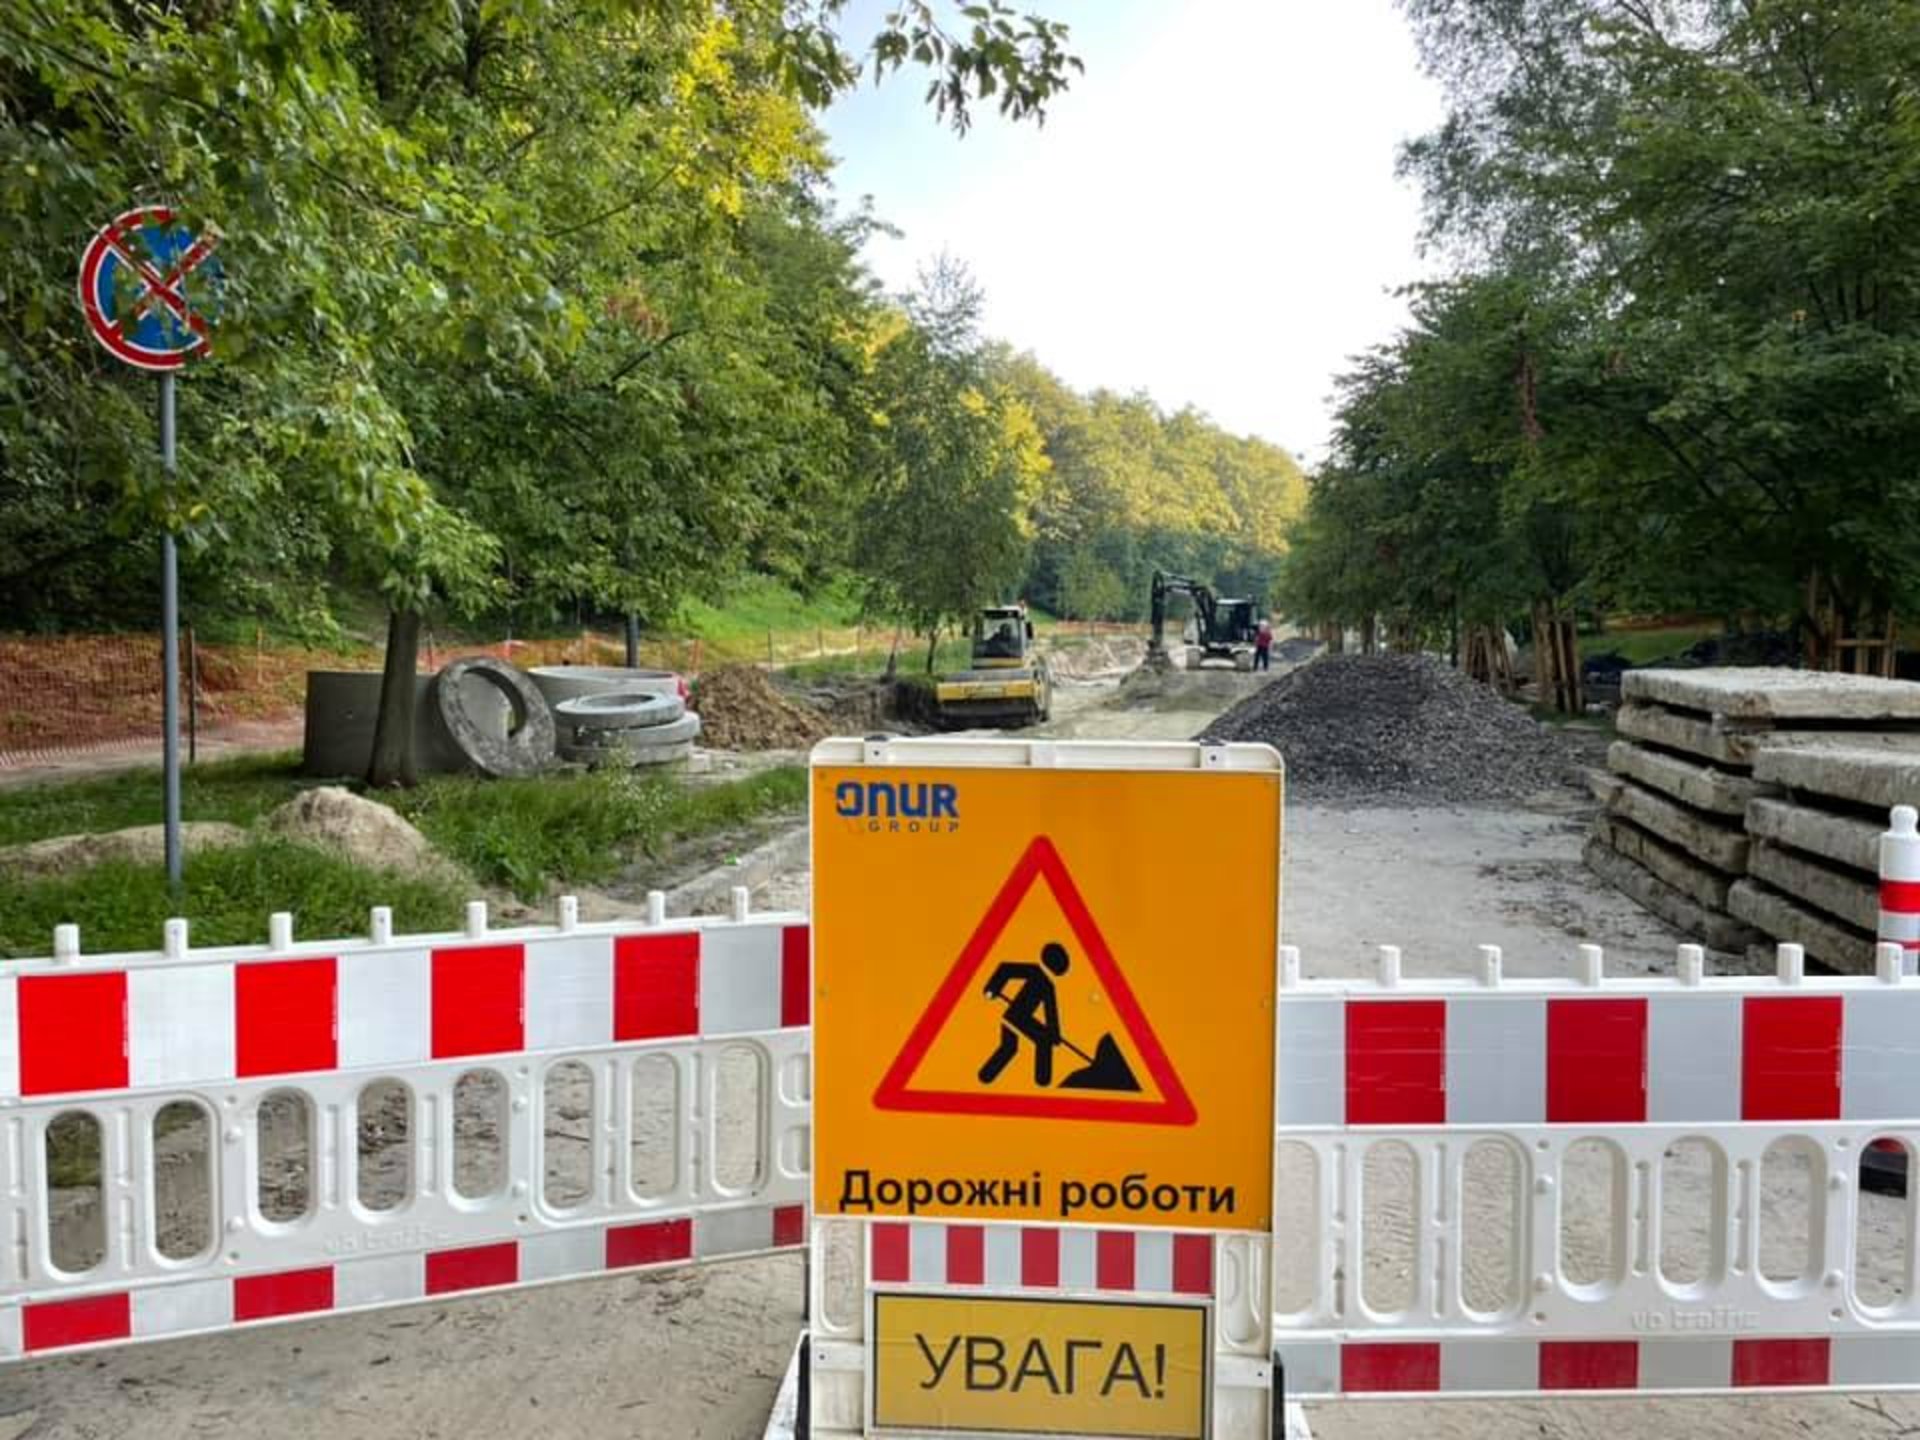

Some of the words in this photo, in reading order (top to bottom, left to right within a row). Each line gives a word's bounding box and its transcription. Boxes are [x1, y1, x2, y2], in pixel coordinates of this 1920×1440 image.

[835, 781, 959, 818] ONUR
[868, 820, 959, 833] GROUP
[839, 1169, 1042, 1214] Дорожні
[1060, 1173, 1236, 1217] роботи
[915, 1332, 1166, 1399] УВАГА!
